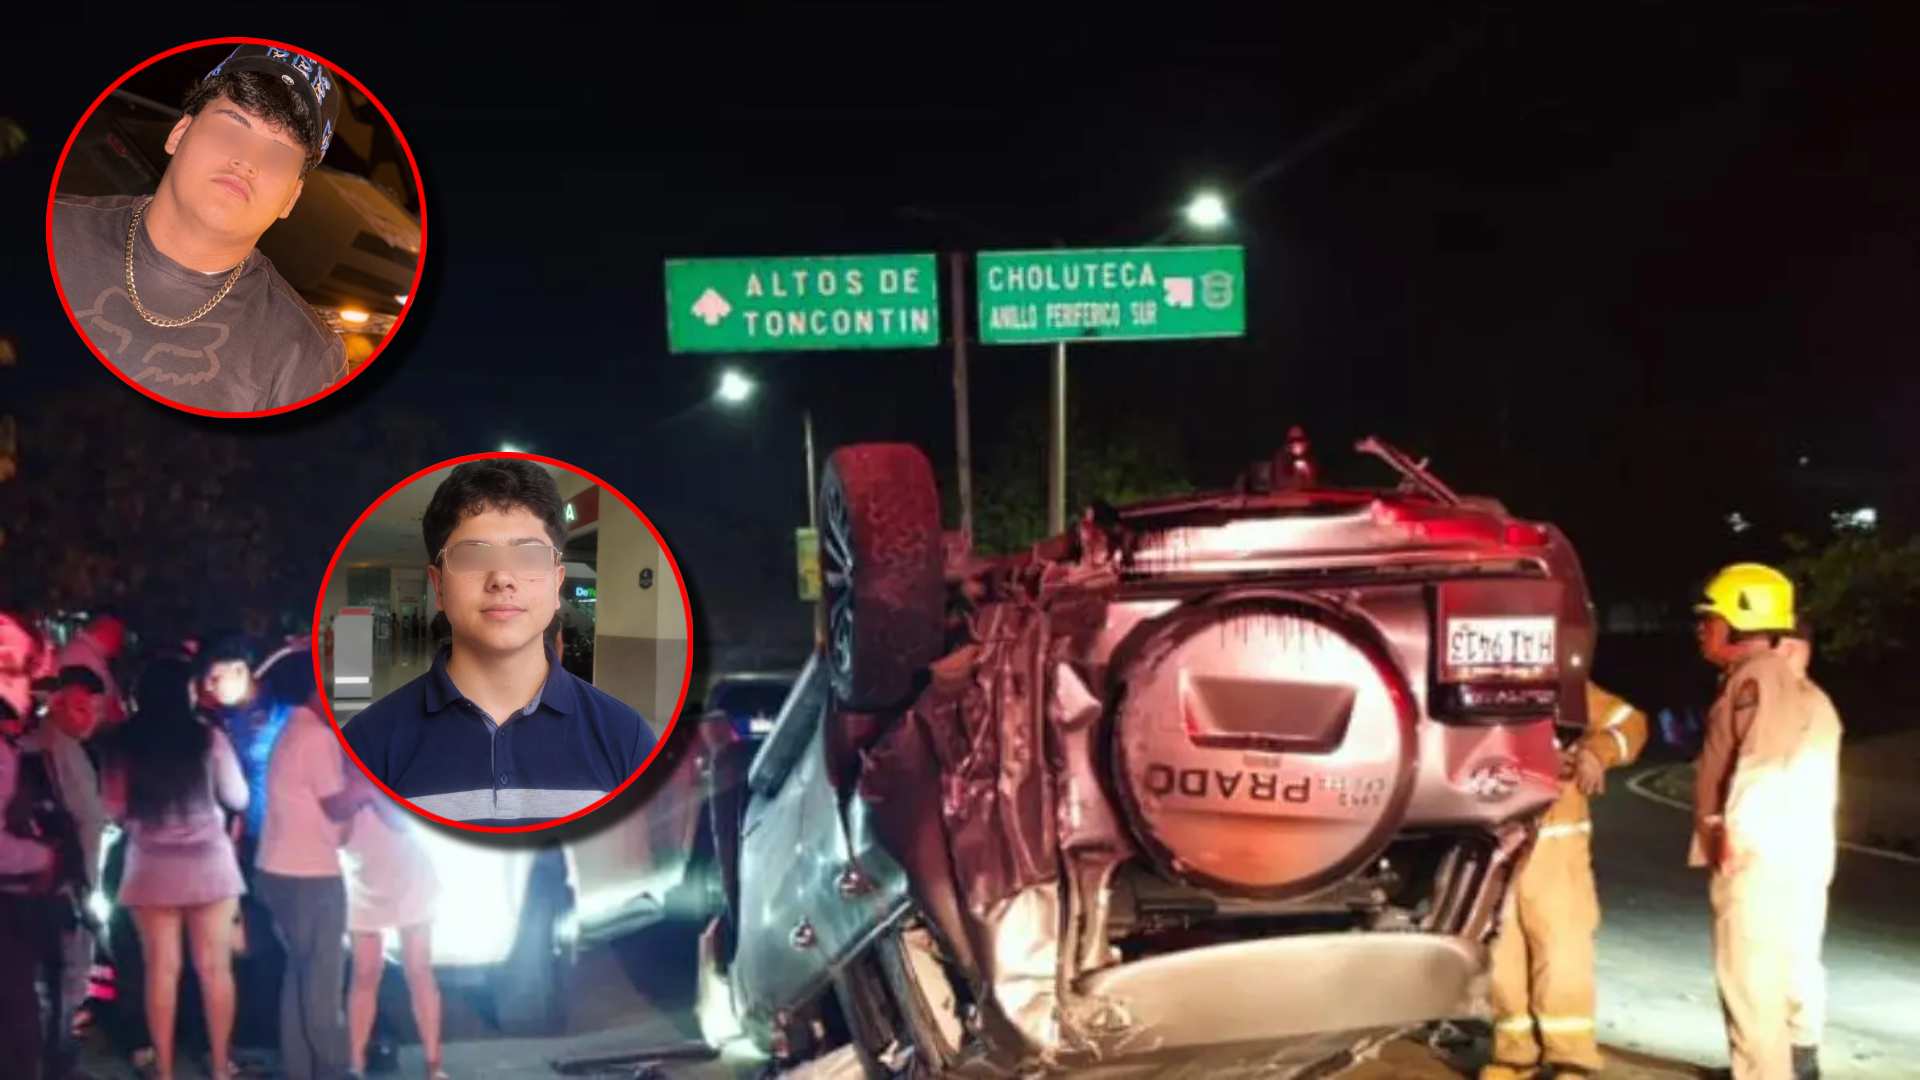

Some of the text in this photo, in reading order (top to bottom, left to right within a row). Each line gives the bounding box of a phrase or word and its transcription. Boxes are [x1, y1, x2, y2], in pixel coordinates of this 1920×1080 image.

[746, 267, 920, 297] ALTOS DE
[988, 262, 1156, 291] CHOLUTECA
[744, 307, 930, 337] TONCONTIN
[989, 300, 1158, 329] ANILLO PERIFERICO SUR
[1145, 763, 1311, 803] PRADO
